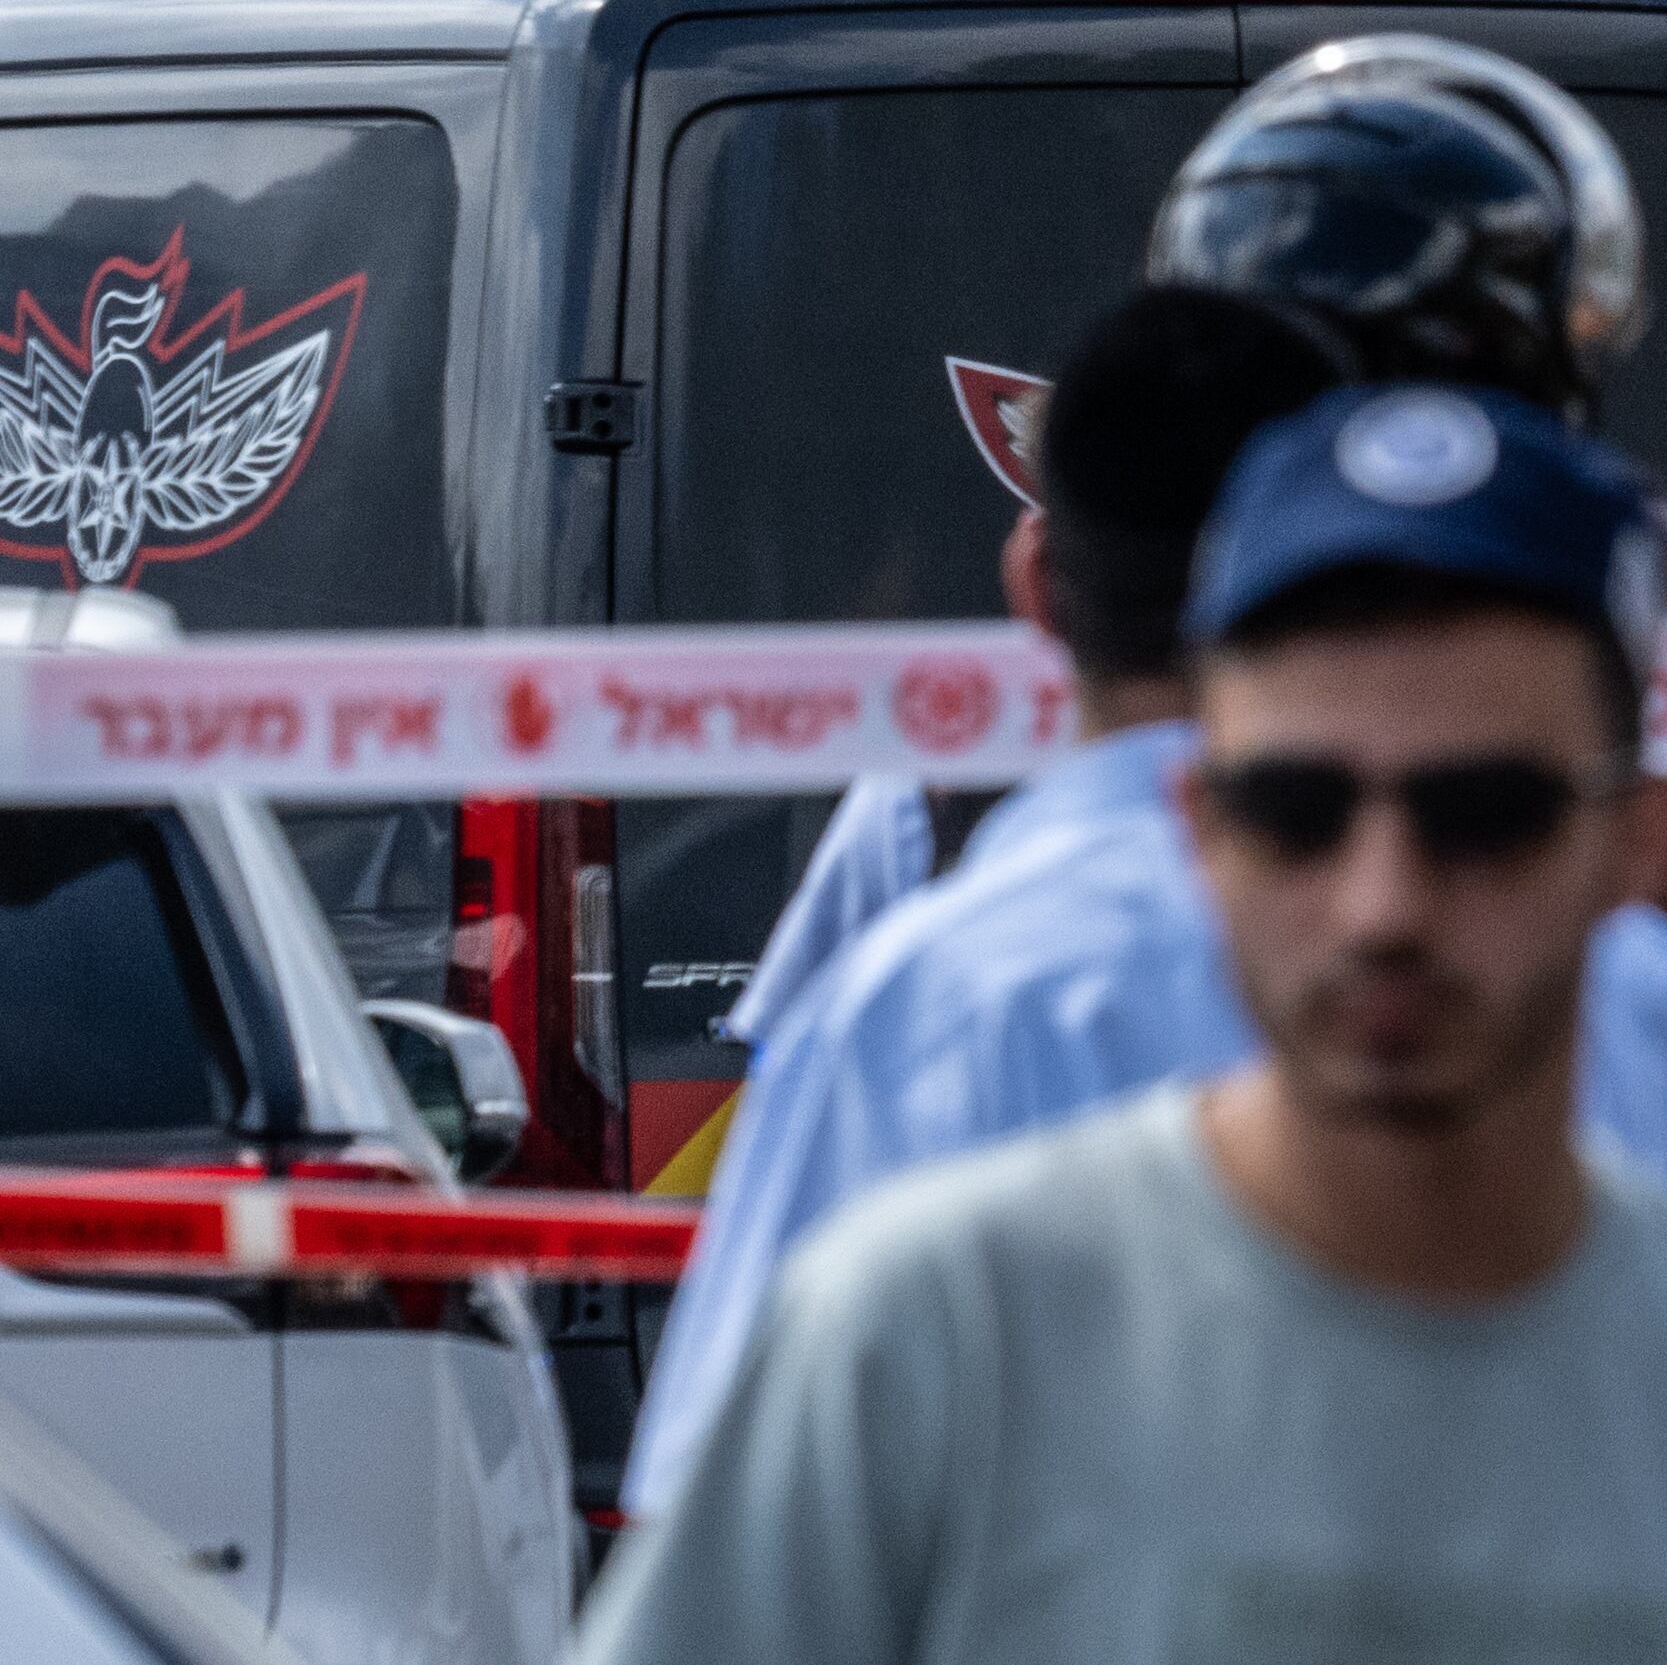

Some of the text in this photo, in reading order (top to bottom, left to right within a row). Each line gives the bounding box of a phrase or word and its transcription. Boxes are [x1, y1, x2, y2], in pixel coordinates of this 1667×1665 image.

[79, 672, 860, 770] ישראל אין מעבר
